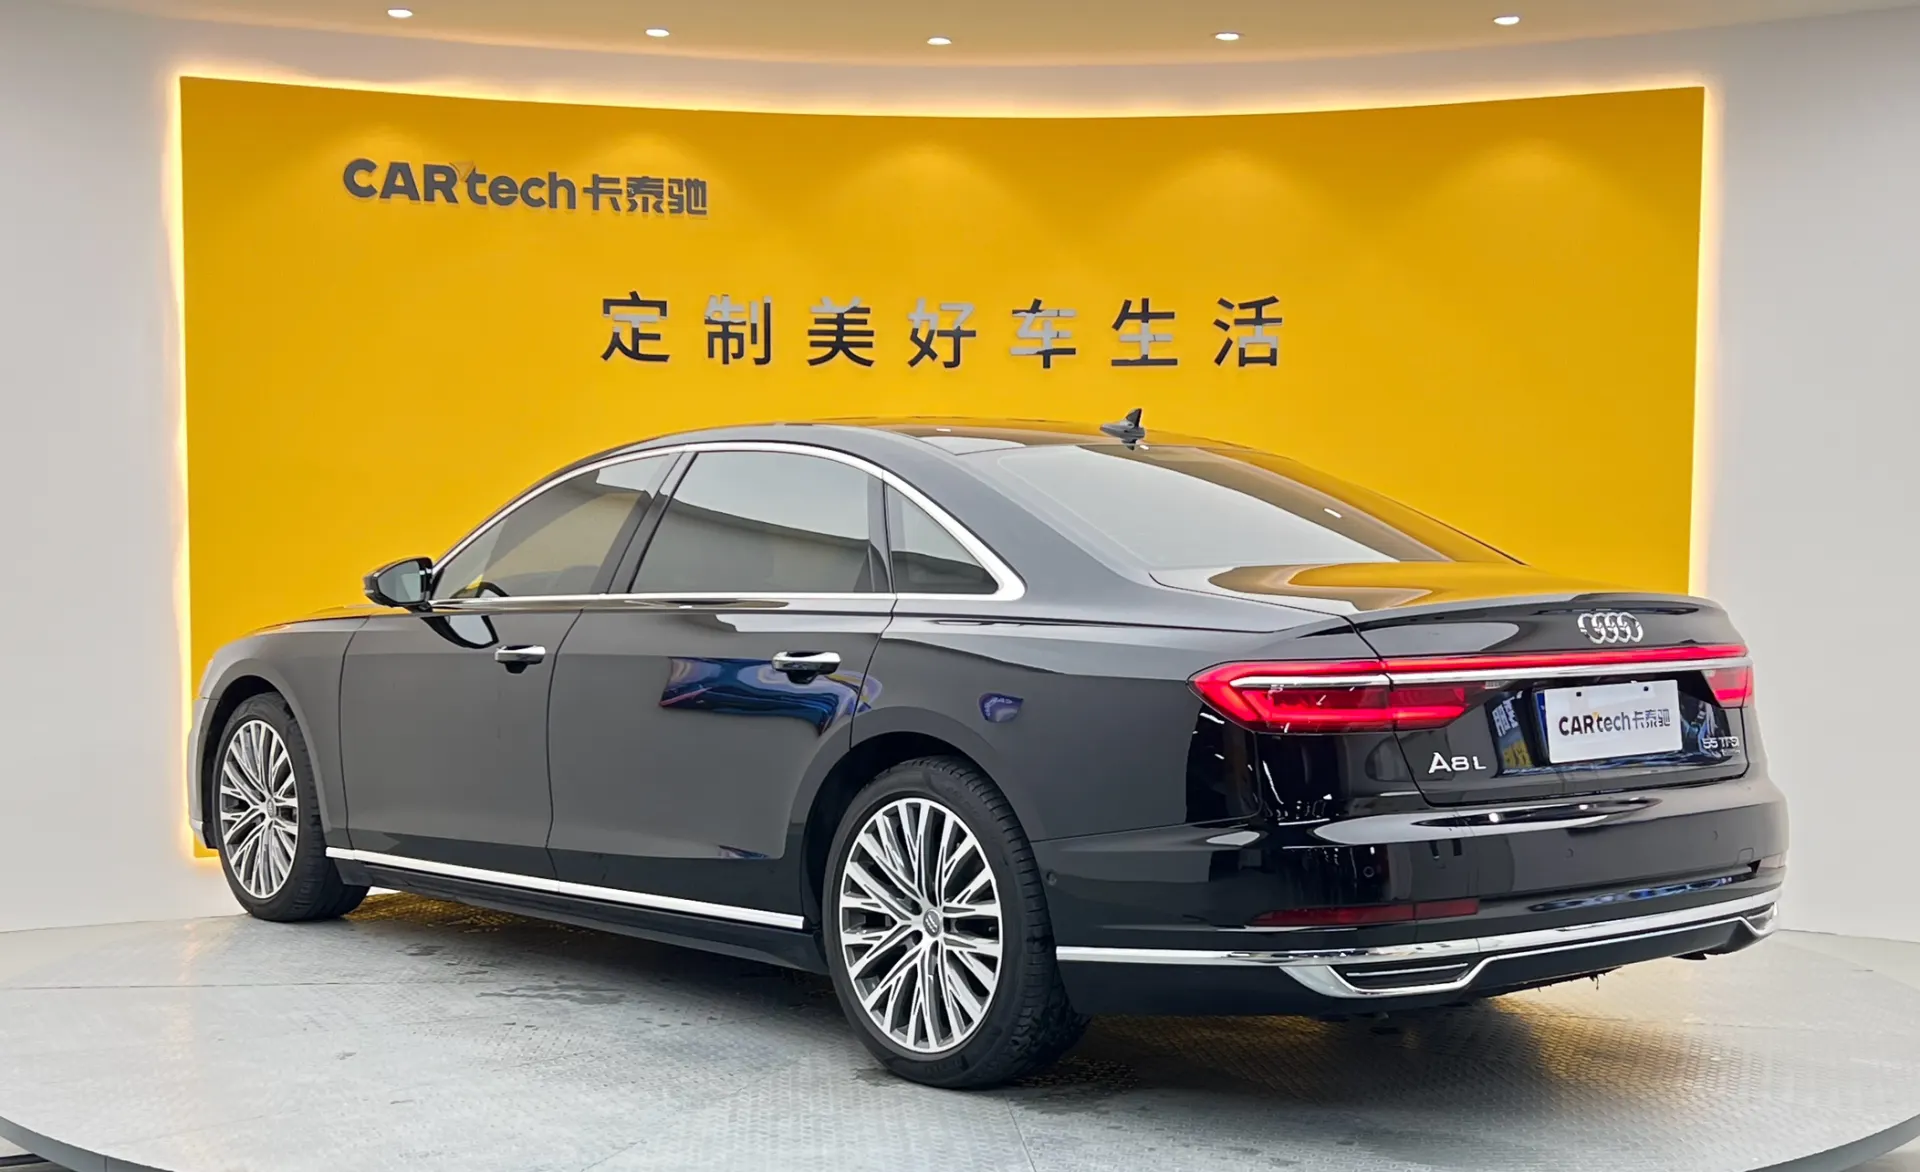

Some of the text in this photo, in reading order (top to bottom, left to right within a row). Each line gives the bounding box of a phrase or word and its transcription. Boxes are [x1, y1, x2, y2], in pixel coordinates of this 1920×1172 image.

[582, 172, 708, 216] 卡泰驰
[600, 290, 1283, 369] 定制美好车生活
